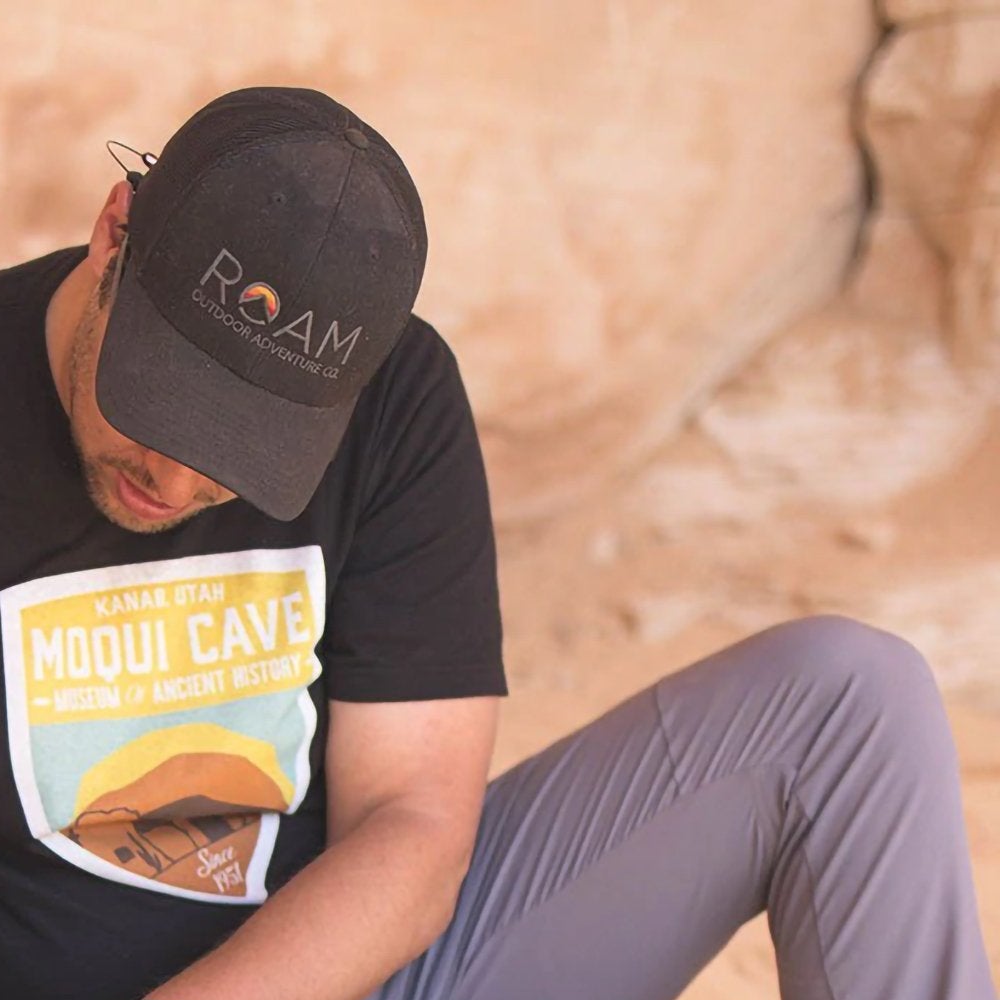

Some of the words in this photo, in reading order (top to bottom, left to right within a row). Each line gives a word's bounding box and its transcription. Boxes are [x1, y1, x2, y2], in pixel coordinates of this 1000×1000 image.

[191, 288, 251, 340] OUTDOOR
[251, 333, 323, 375] ADVENTURE
[200, 248, 363, 365] ROAM
[31, 620, 169, 682] MOQUI
[187, 591, 310, 664] CAVE
[174, 582, 225, 605] UTAH
[54, 686, 120, 711] MUSEUM
[152, 669, 225, 705] ANCIENT
[232, 654, 301, 689] HISTORY
